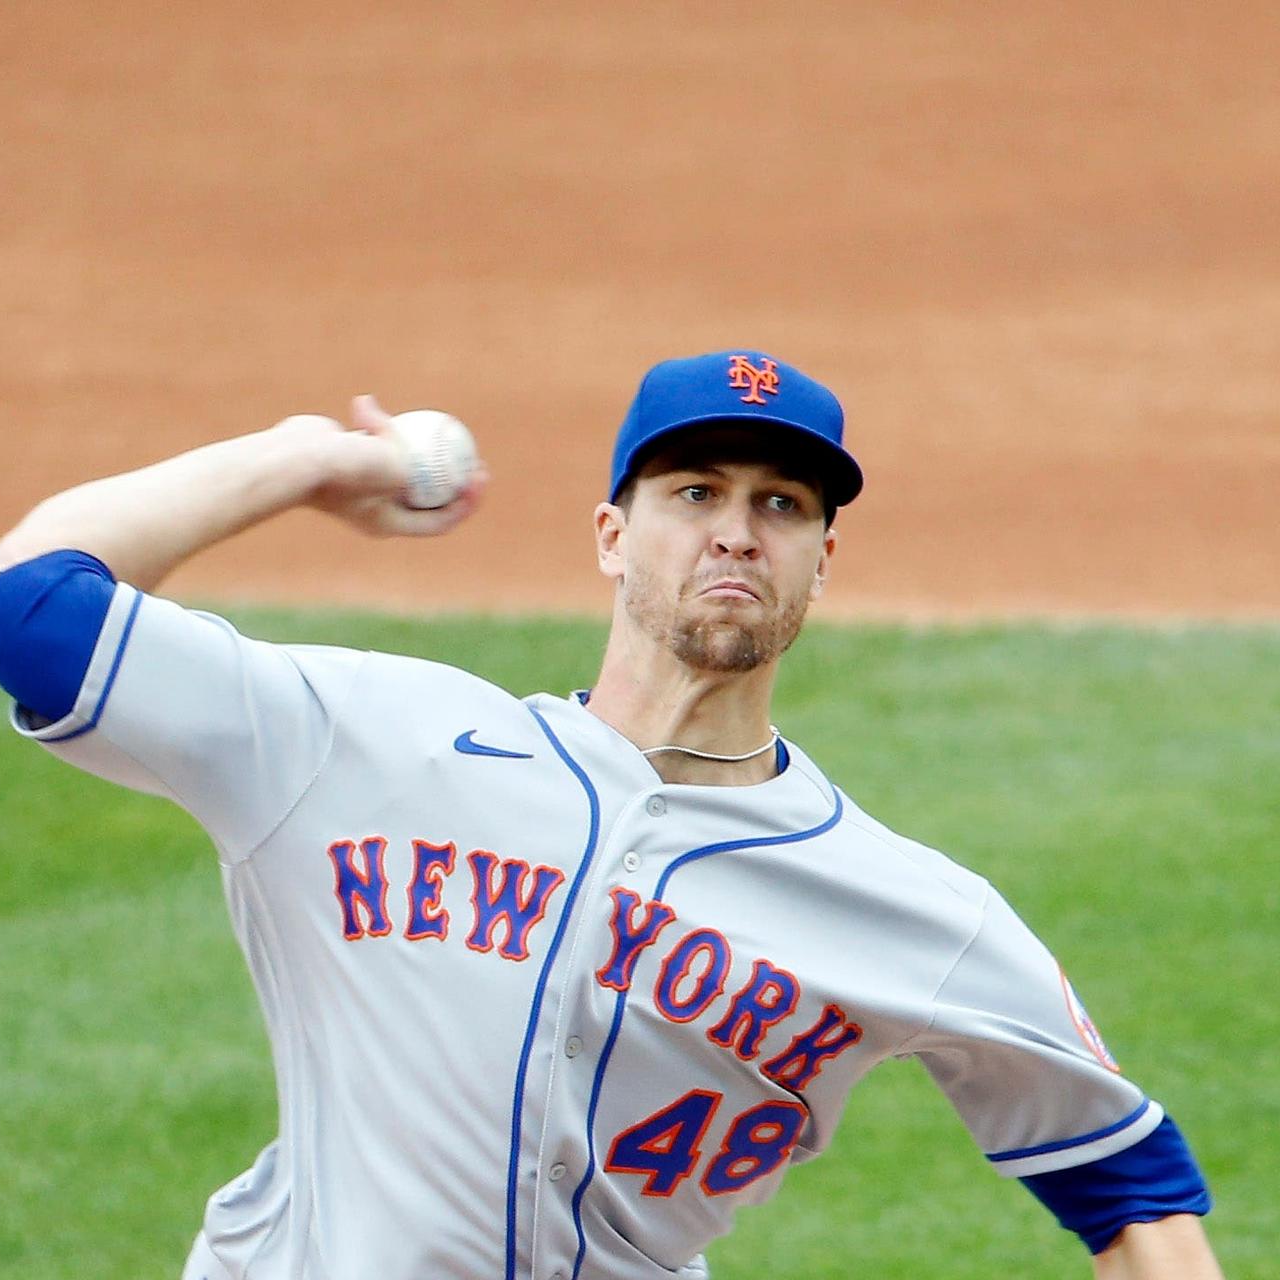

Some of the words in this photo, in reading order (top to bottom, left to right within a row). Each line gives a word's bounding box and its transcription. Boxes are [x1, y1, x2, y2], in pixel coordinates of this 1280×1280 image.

[728, 355, 780, 405] NY
[327, 836, 566, 962] NEW
[595, 885, 865, 1091] YORK
[603, 1087, 810, 1198] 48
